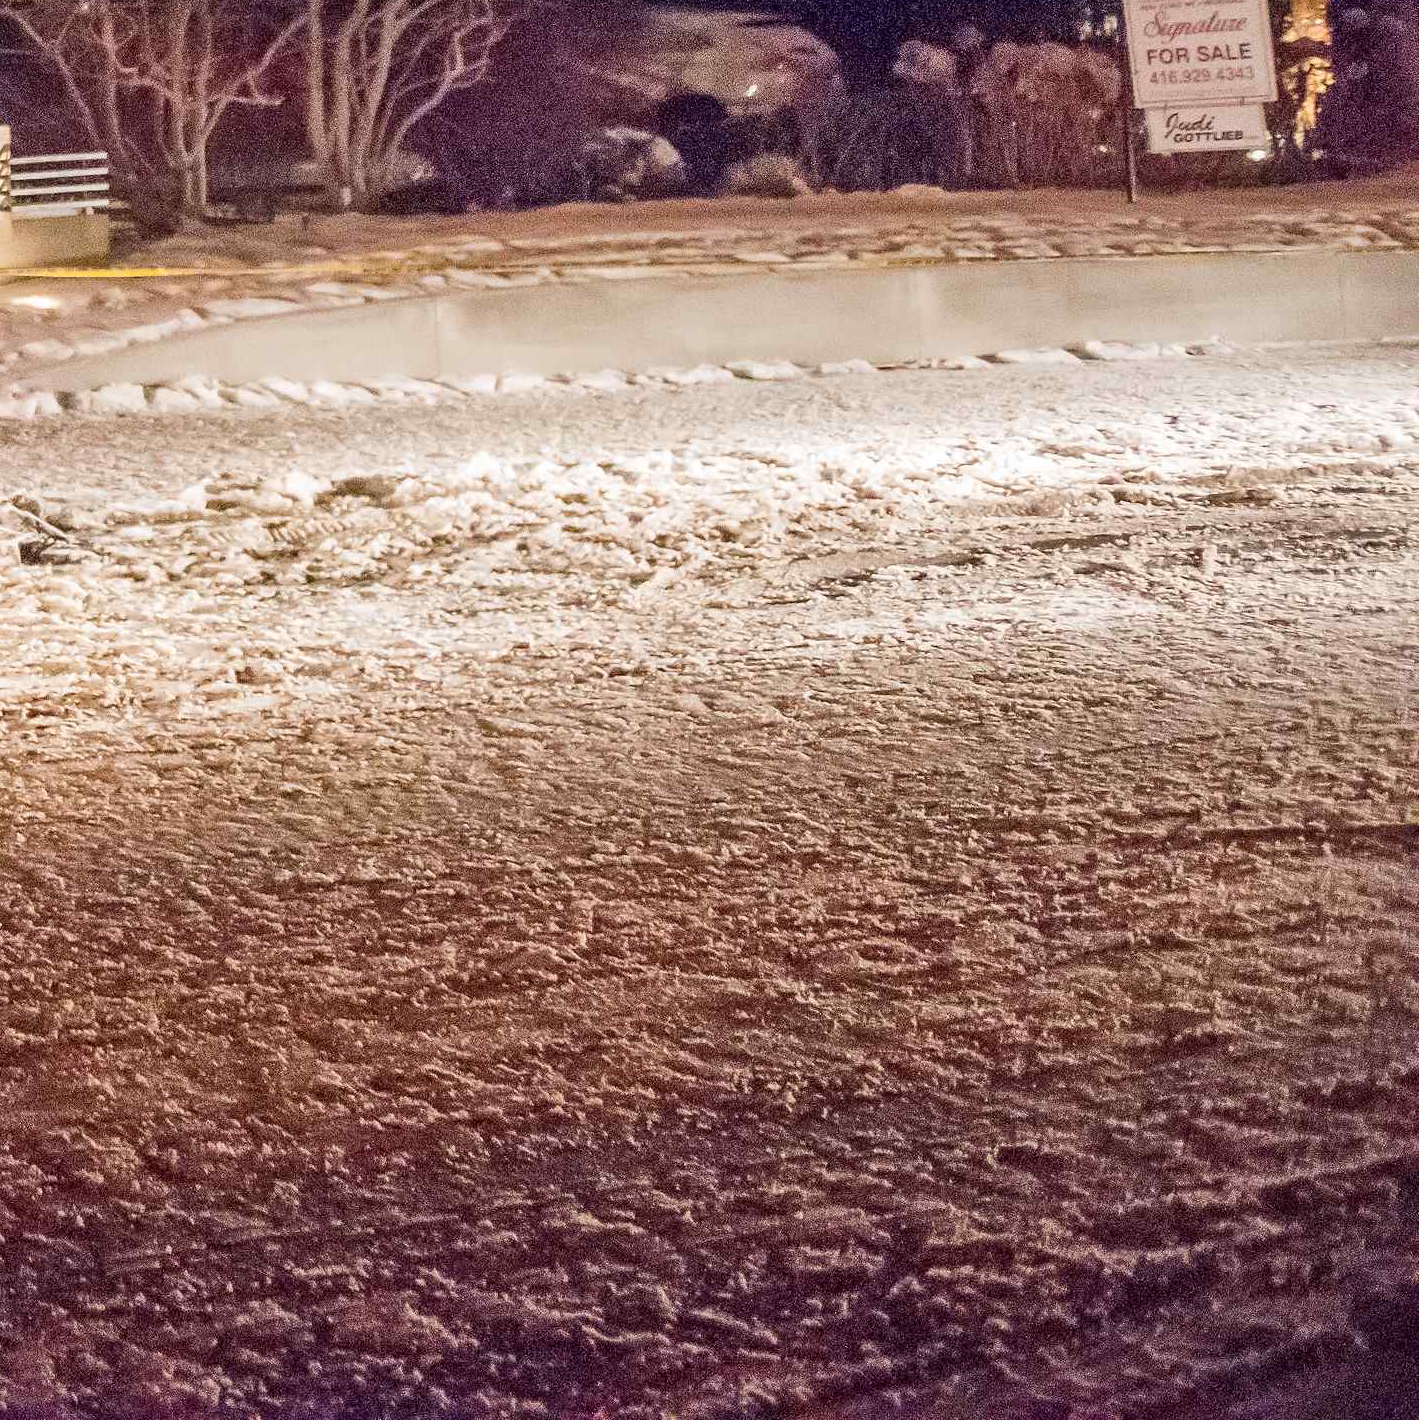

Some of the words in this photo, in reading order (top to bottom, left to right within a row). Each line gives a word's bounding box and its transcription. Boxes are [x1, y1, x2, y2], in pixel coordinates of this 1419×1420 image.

[1144, 10, 1248, 43] Signature
[1146, 47, 1190, 66] FOR
[1197, 42, 1252, 62] SALE
[1172, 130, 1244, 143] GOTTLIEB
